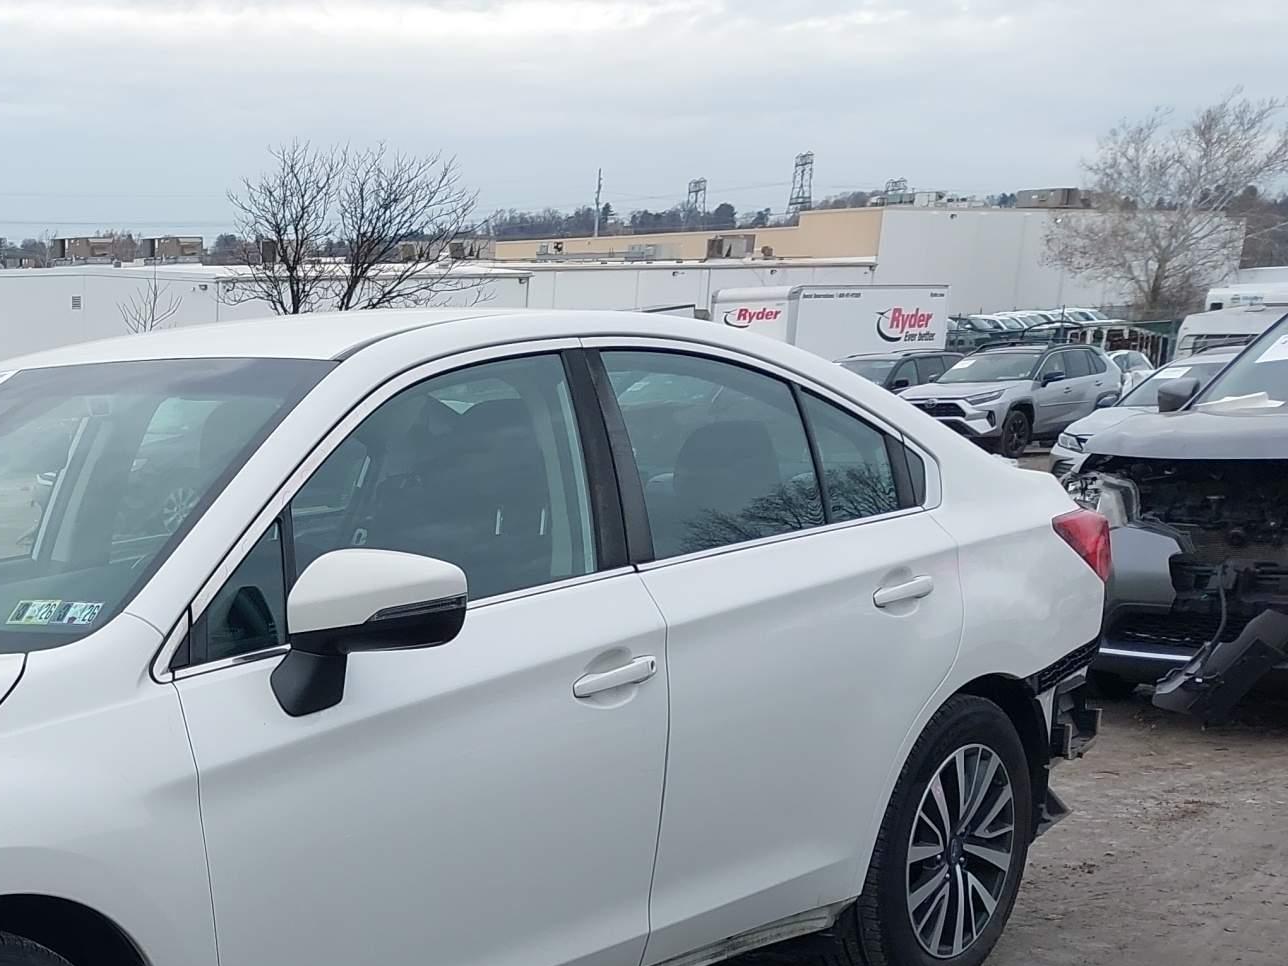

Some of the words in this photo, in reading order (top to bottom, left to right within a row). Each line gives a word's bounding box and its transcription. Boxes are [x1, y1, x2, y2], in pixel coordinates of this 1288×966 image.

[737, 308, 782, 324] Ryder
[889, 307, 933, 334] Ryder
[904, 331, 917, 342] Ever
[918, 331, 936, 341] better
[80, 604, 100, 622] 26
